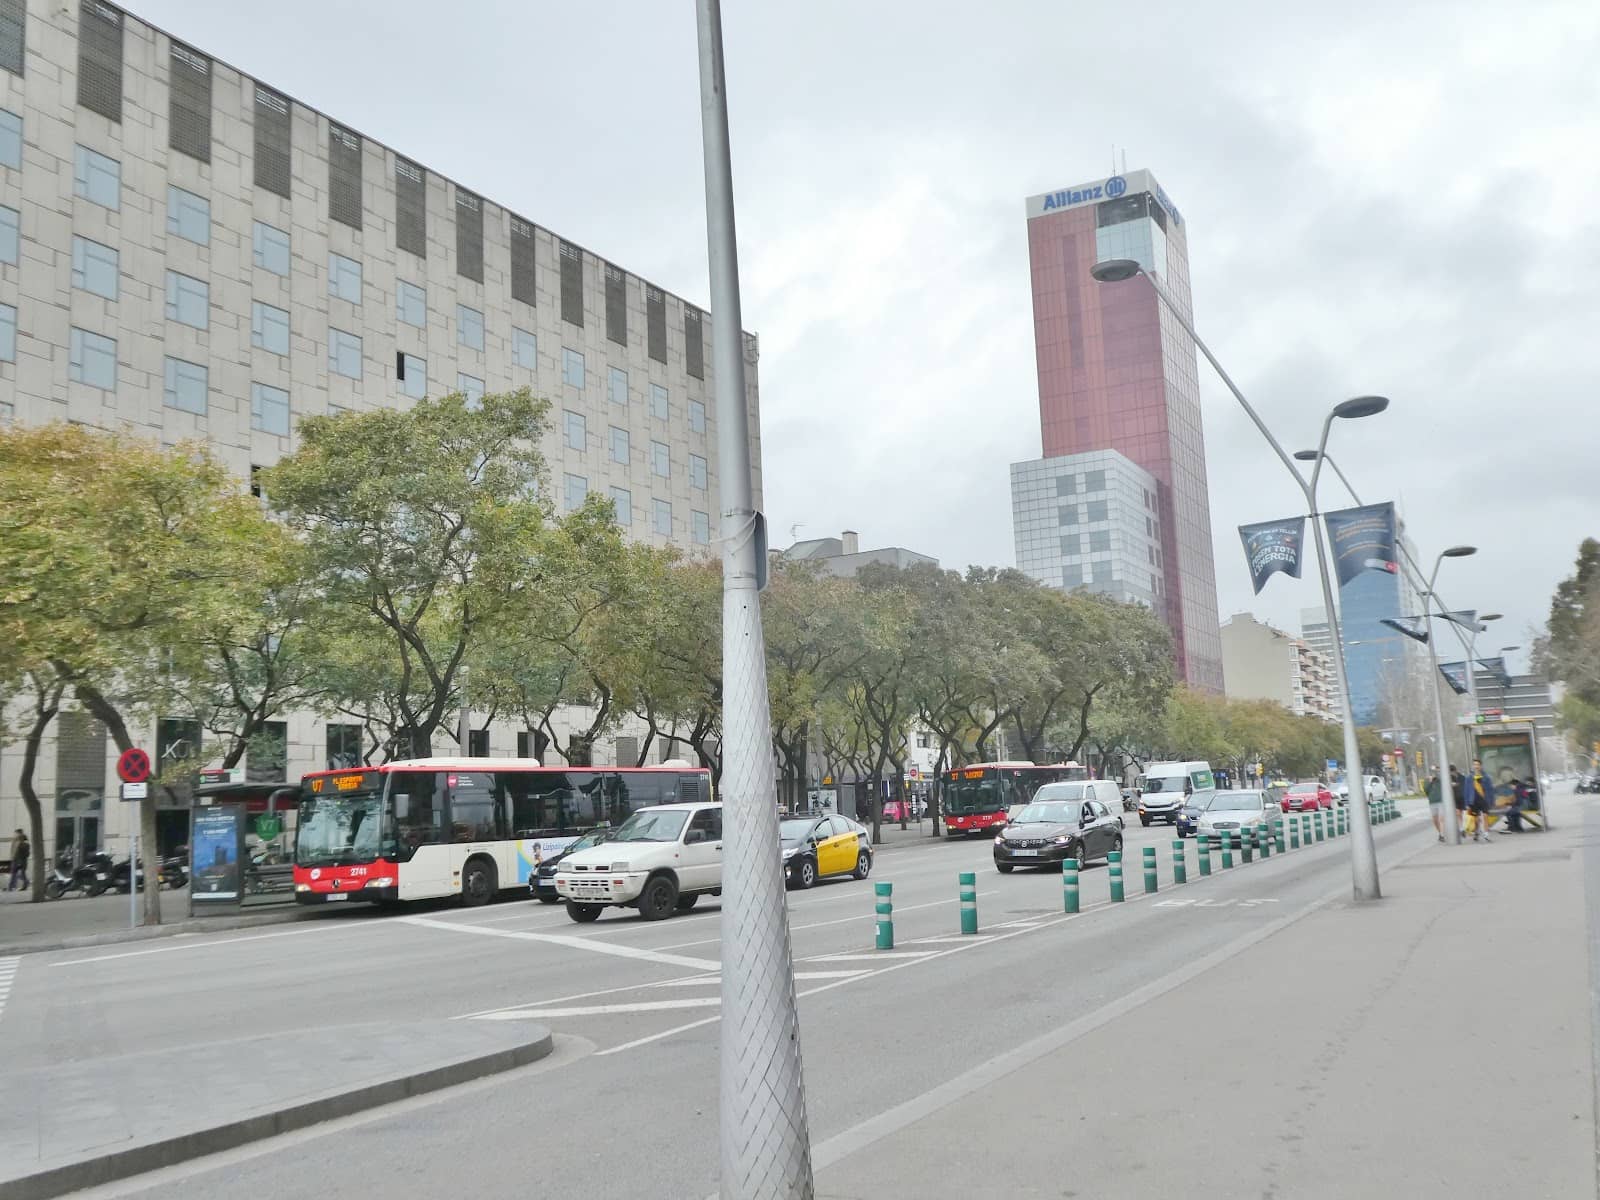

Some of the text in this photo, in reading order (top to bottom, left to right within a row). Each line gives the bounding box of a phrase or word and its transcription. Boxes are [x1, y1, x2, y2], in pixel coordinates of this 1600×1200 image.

[1043, 185, 1103, 211] Allianz
[260, 819, 275, 832] V7
[350, 867, 367, 877] 2741
[1151, 898, 1280, 907] BUS
